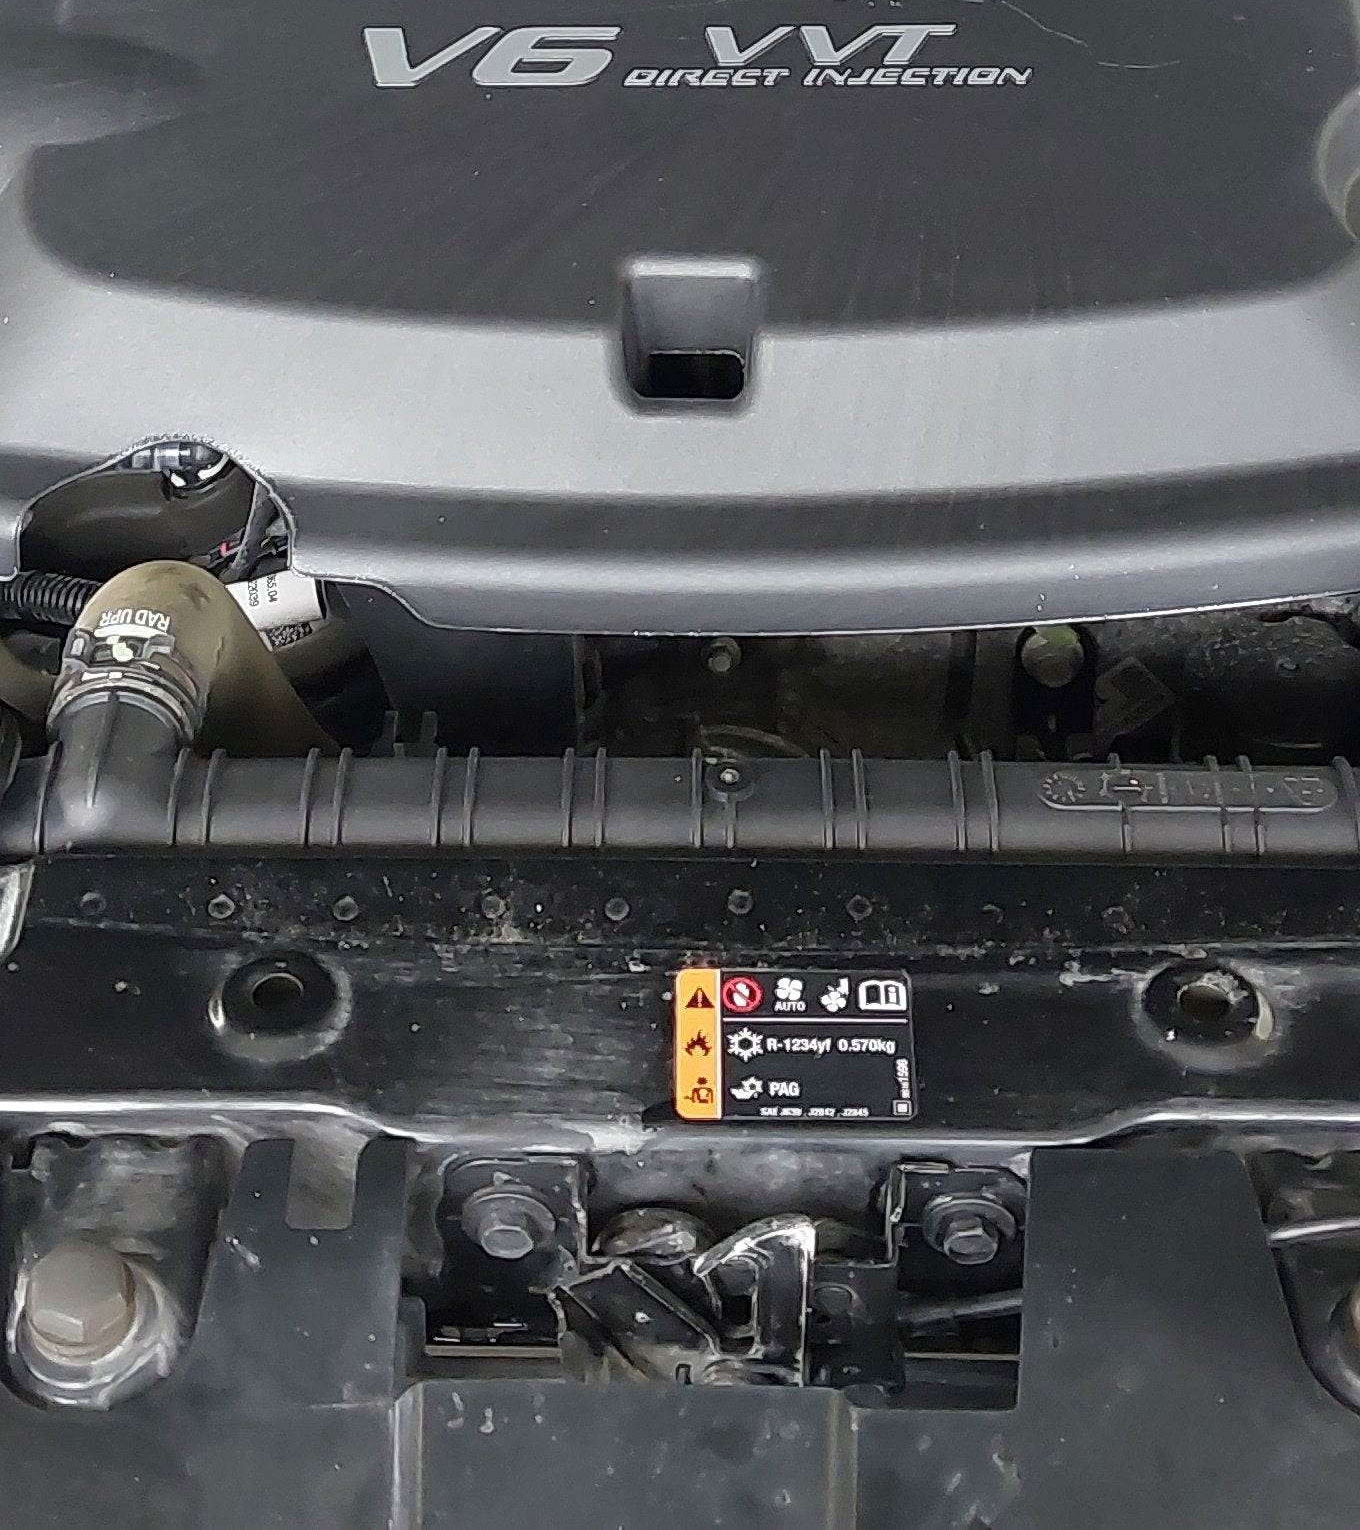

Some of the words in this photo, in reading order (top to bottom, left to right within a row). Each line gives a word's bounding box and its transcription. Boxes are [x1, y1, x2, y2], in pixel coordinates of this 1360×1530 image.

[361, 24, 624, 88] V6
[702, 23, 958, 67] VVT
[623, 66, 791, 87] DIRECT
[801, 66, 1034, 87] INJECTION
[99, 608, 133, 627] UPR
[135, 609, 171, 633] RAD
[774, 1001, 806, 1012] AUTO
[766, 1037, 832, 1055] R-1234yf
[838, 1038, 896, 1056] 0.570kg
[768, 1081, 800, 1097] PAG
